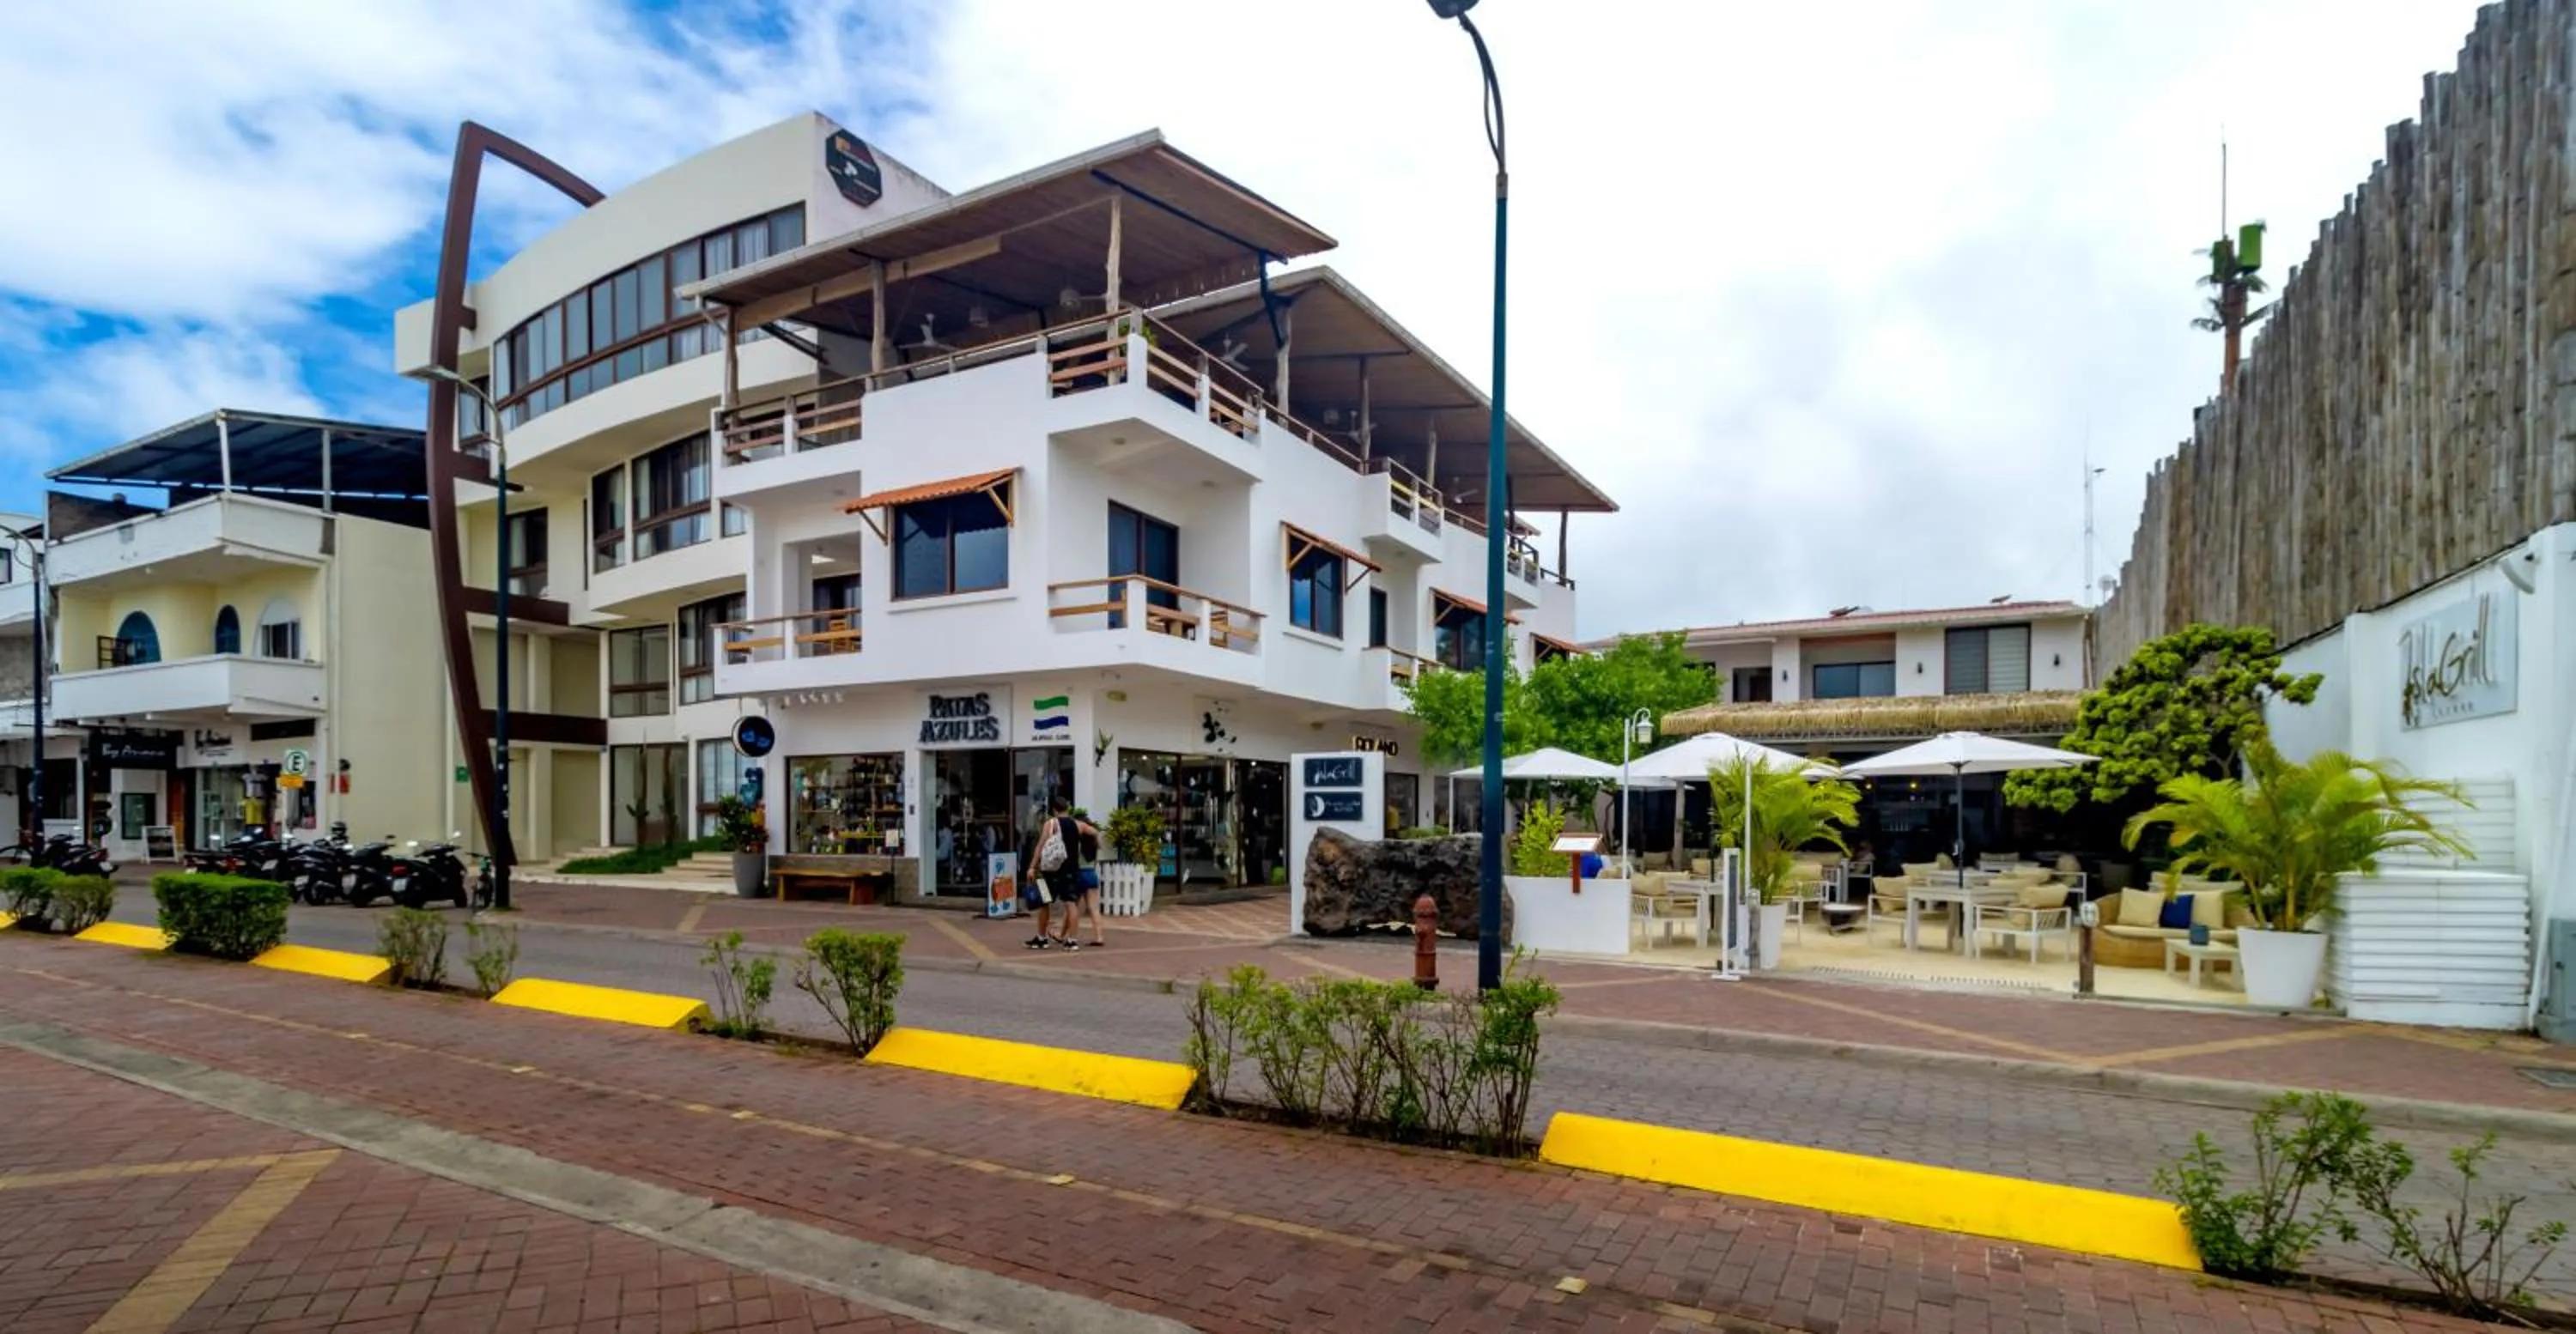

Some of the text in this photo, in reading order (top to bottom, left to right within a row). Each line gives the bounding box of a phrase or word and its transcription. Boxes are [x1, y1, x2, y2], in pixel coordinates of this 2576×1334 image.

[929, 693, 990, 718] PATAS
[919, 716, 999, 743] AZULES
[293, 755, 303, 771] E
